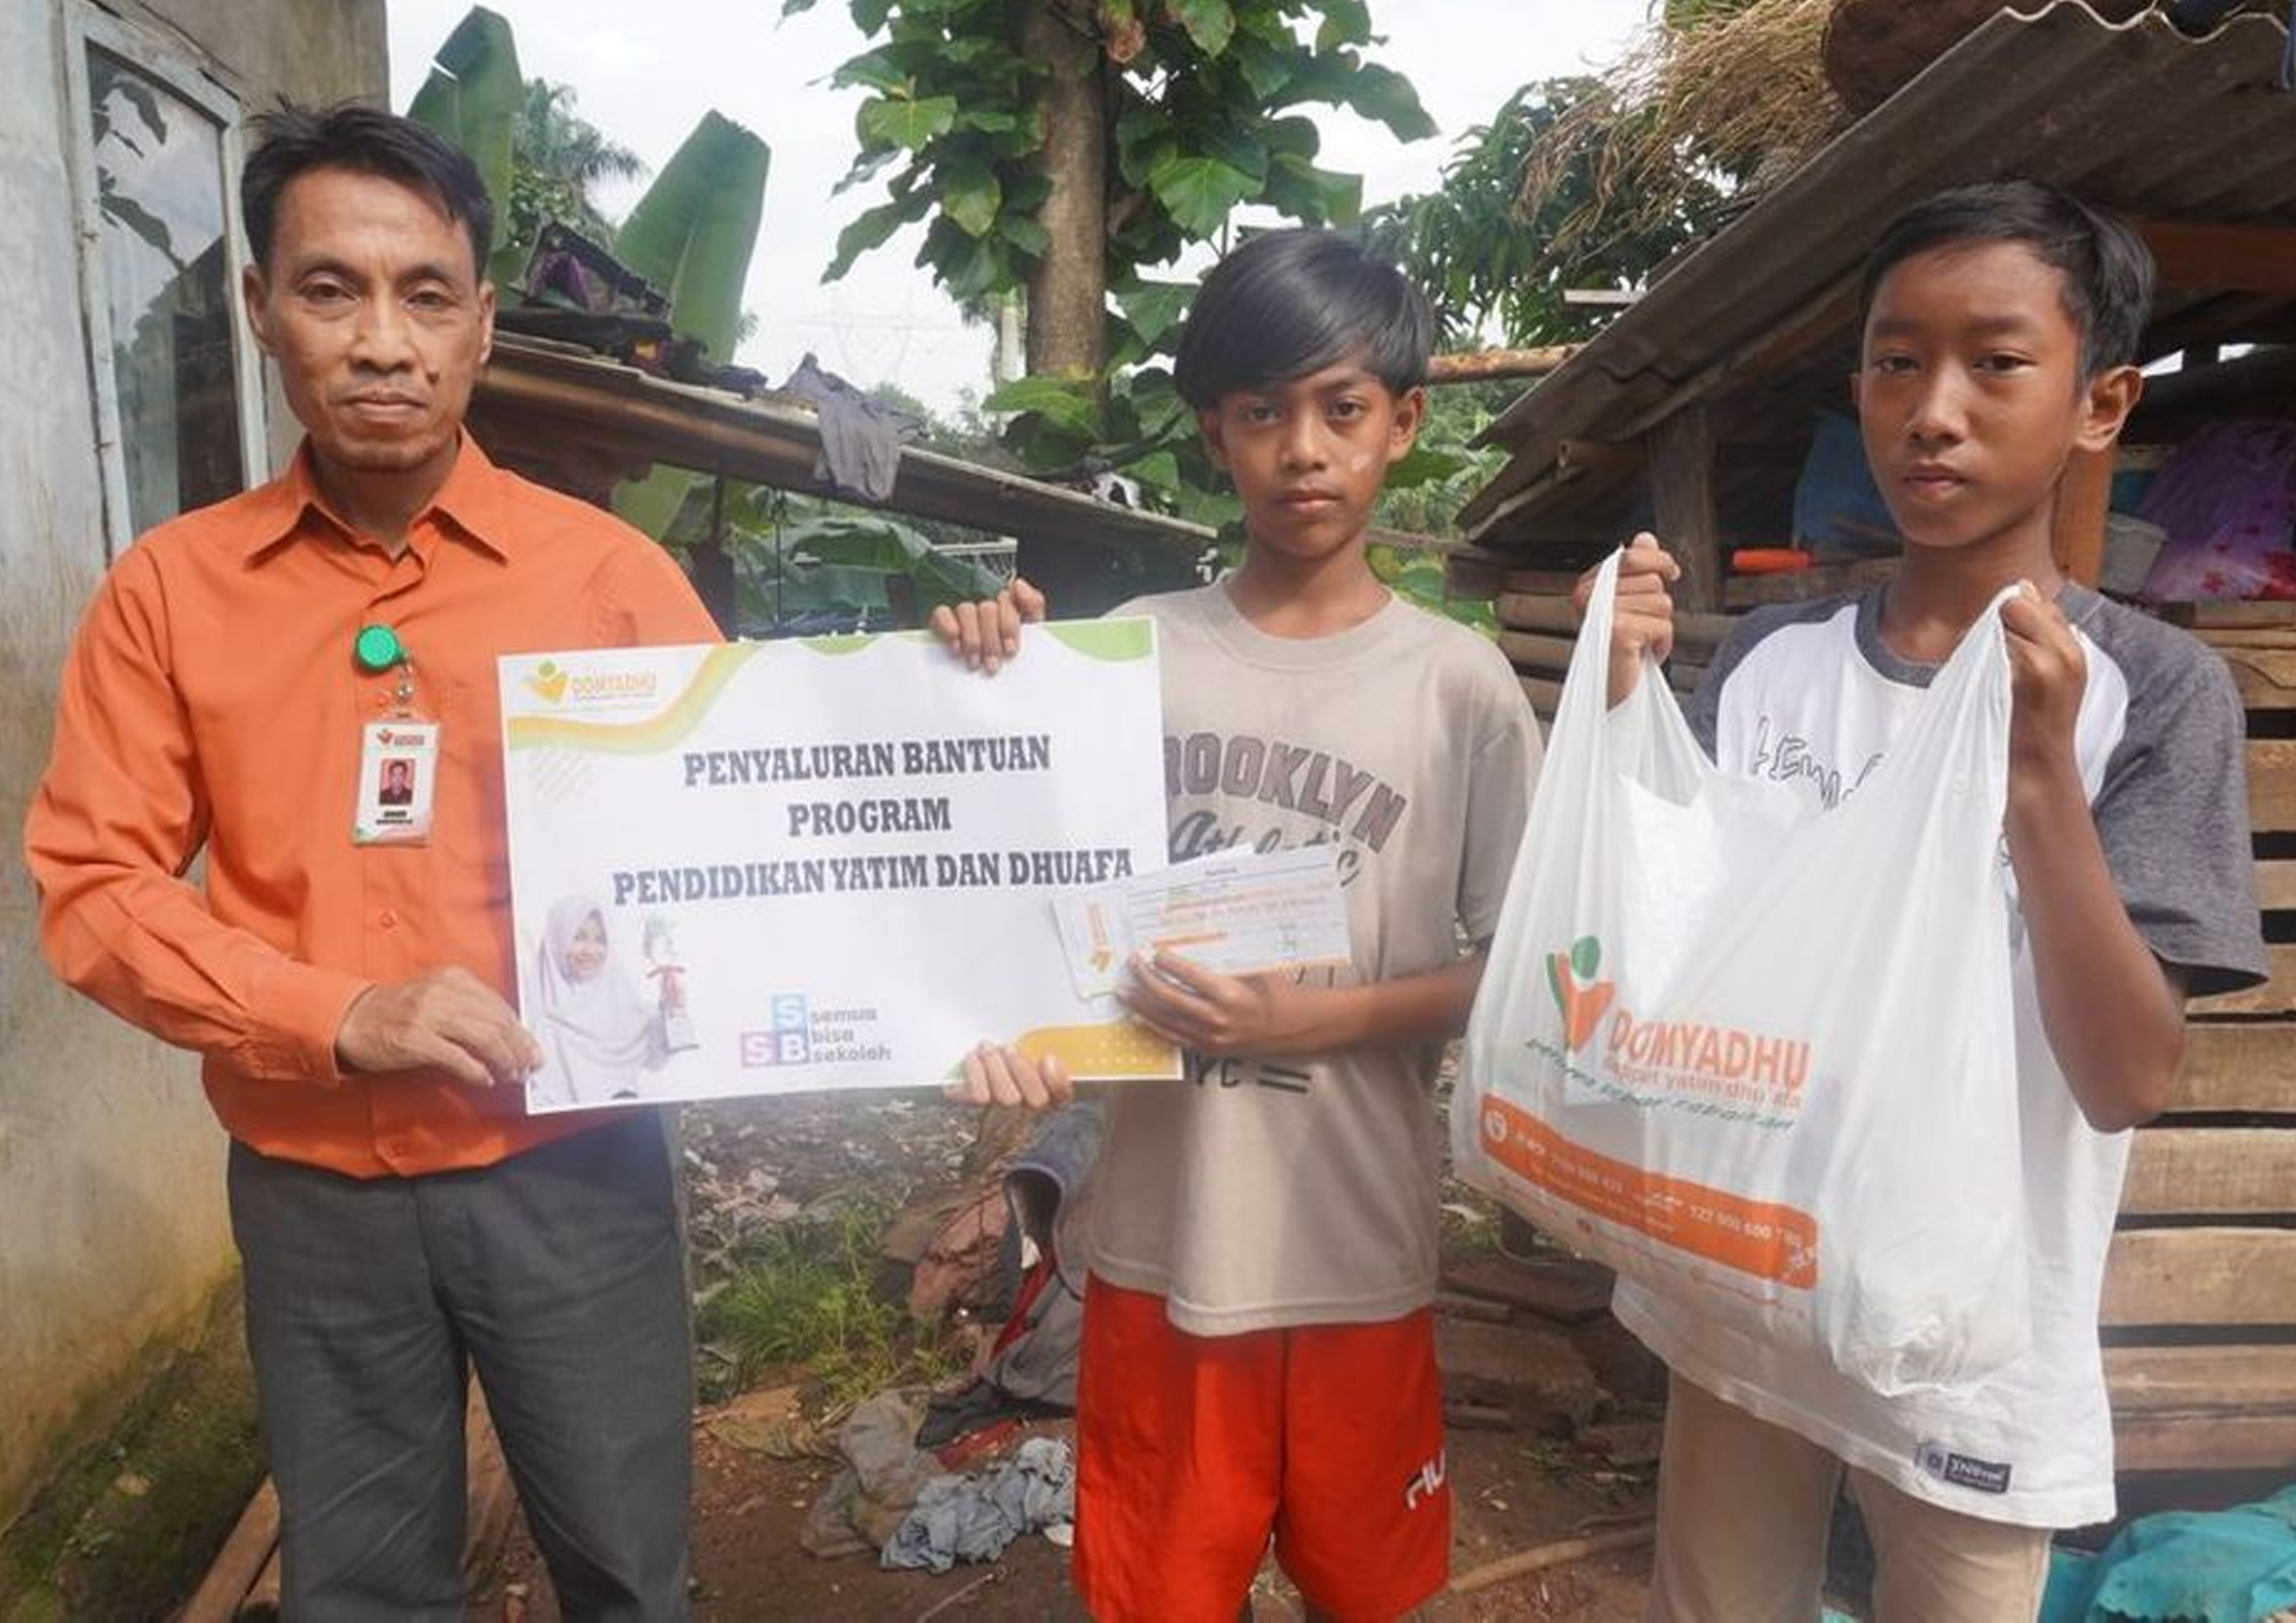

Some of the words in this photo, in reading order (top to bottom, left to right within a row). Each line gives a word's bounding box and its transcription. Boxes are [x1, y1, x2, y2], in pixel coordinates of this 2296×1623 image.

[683, 742, 895, 786] PENYALURAN
[902, 735, 1050, 774] BANTUAN
[787, 797, 952, 836] PROGRAM
[1164, 732, 1407, 853] OOKLYN
[613, 859, 825, 906] PENDIDIKAN
[830, 853, 929, 891] YATIM
[935, 852, 1000, 887] DAN
[1007, 848, 1134, 885] DHUAFA
[1608, 1007, 1812, 1090] DOMYADHU
